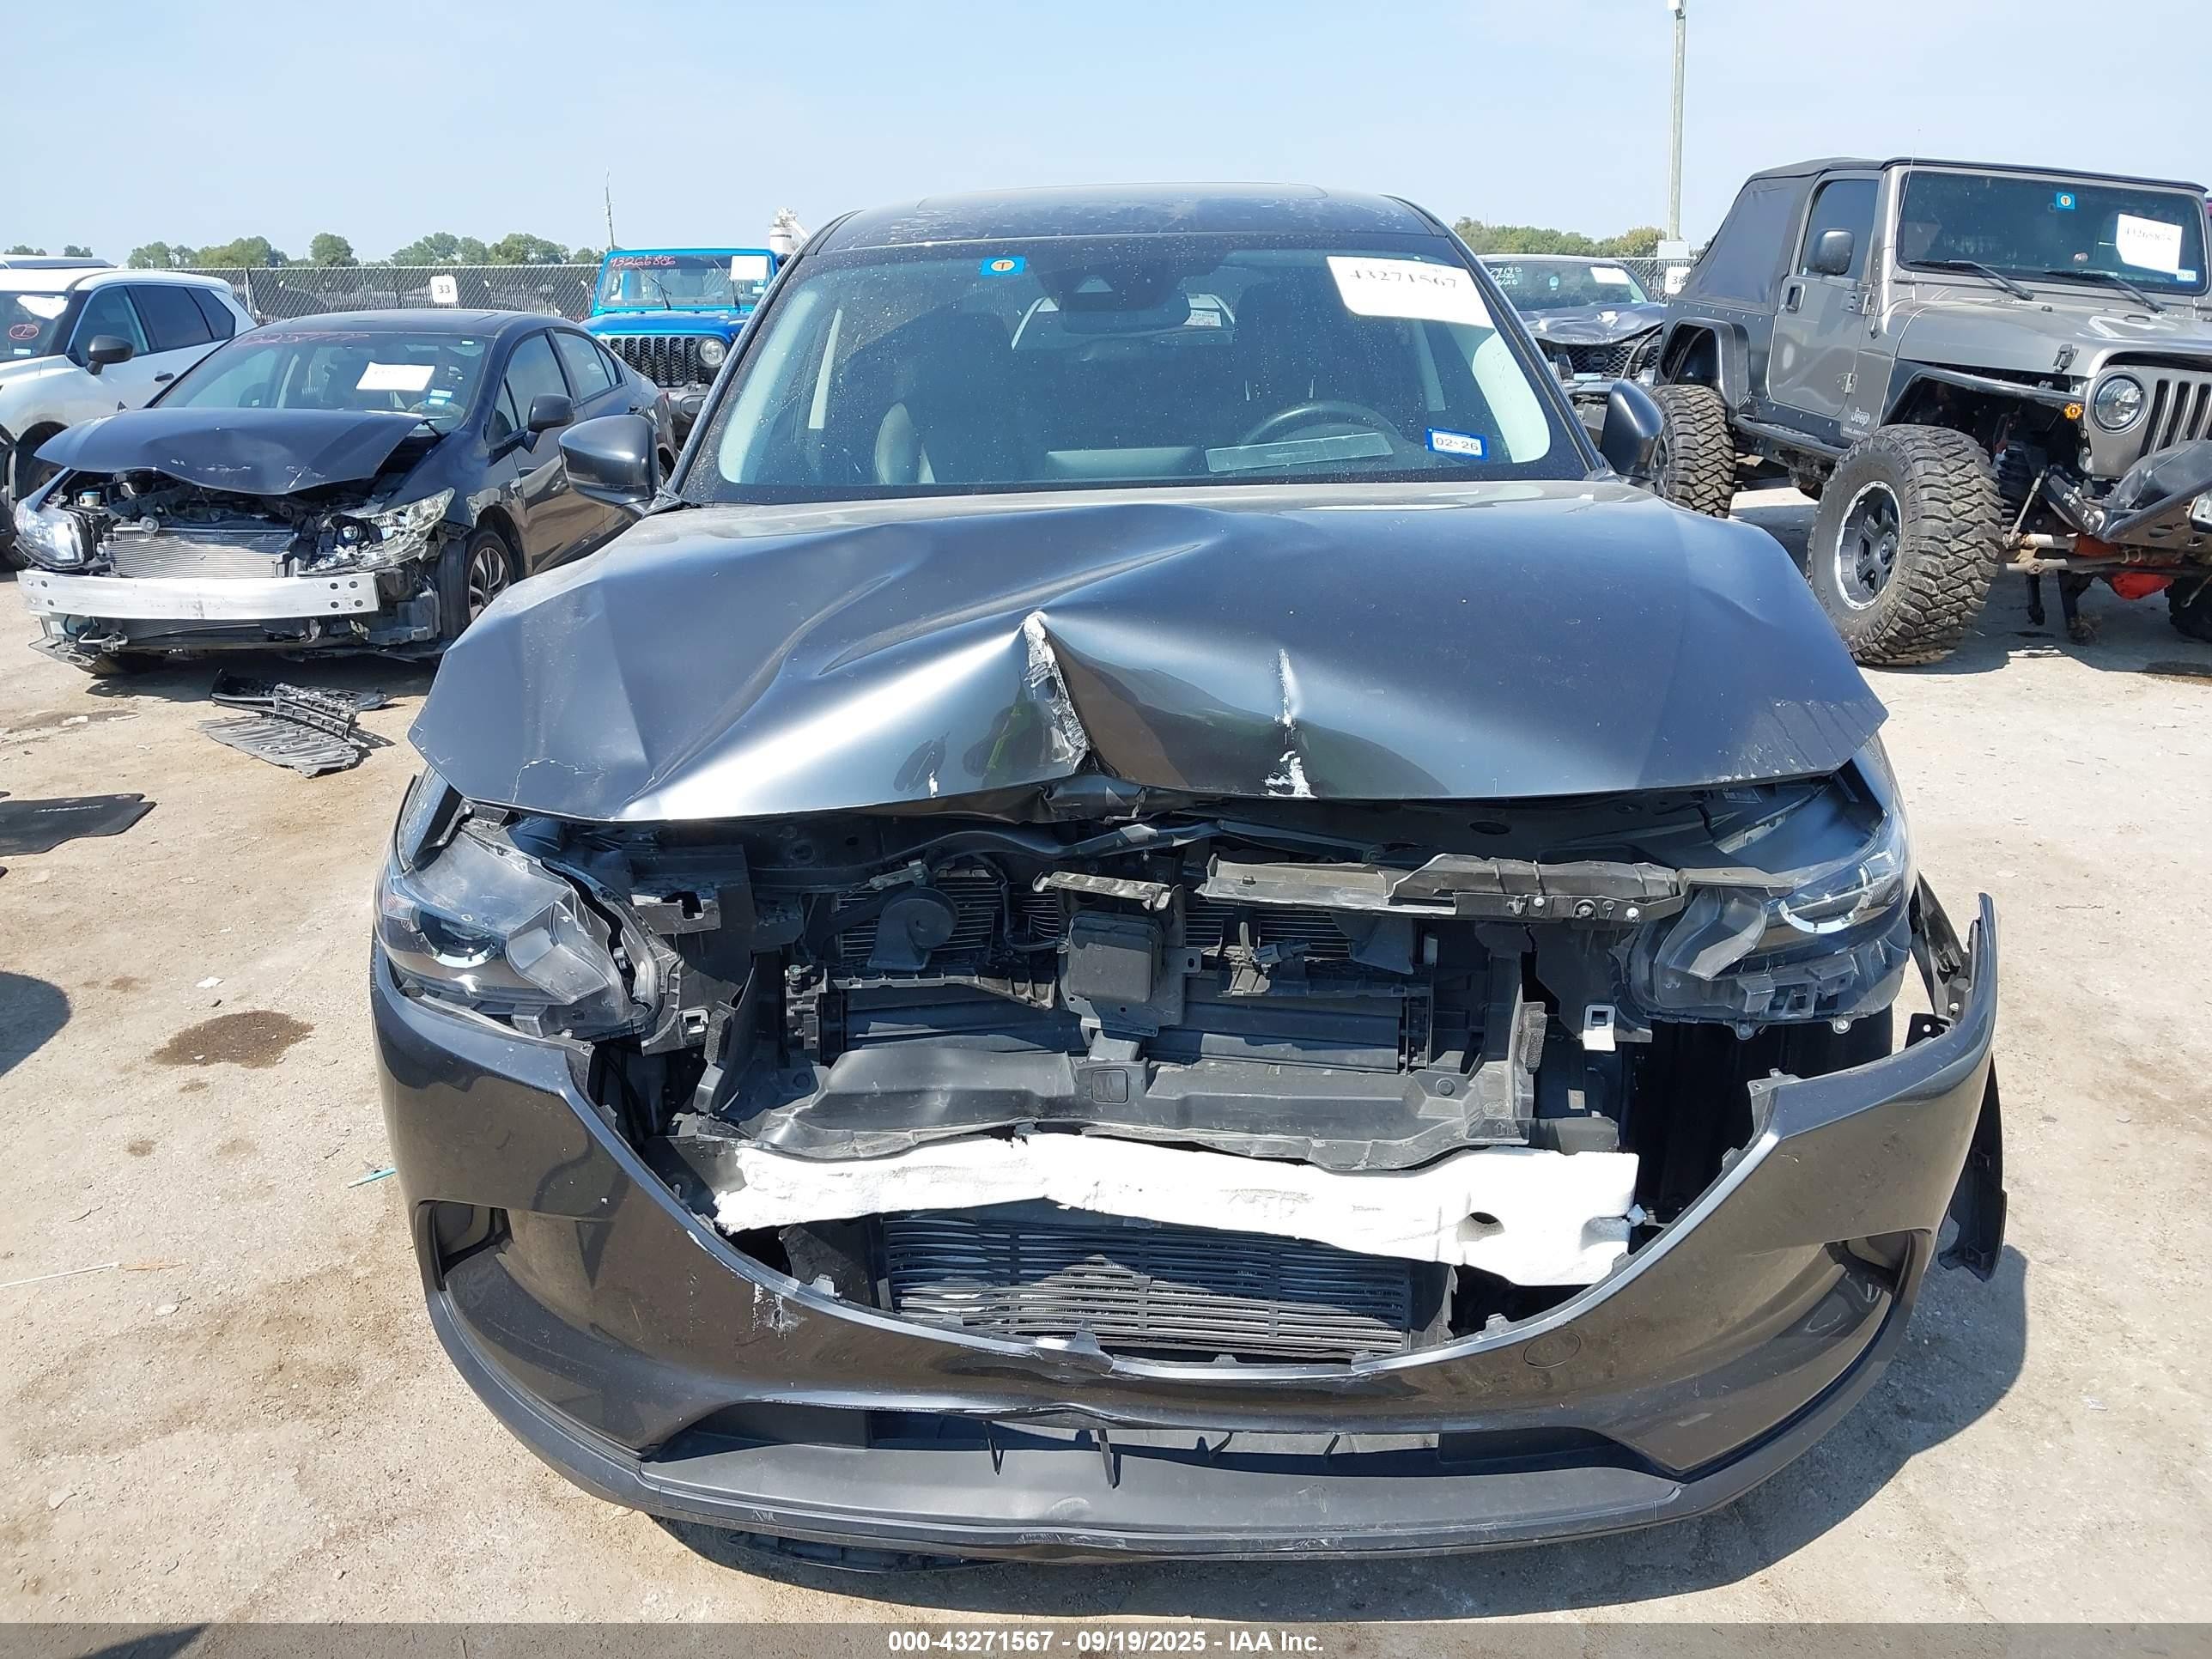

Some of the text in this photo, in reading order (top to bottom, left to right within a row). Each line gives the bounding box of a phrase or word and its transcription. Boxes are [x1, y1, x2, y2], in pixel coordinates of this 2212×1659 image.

[1350, 270, 1457, 289] 43271567
[1671, 276, 1685, 285] 38
[438, 284, 451, 294] 33
[1850, 406, 1870, 427] Jeep
